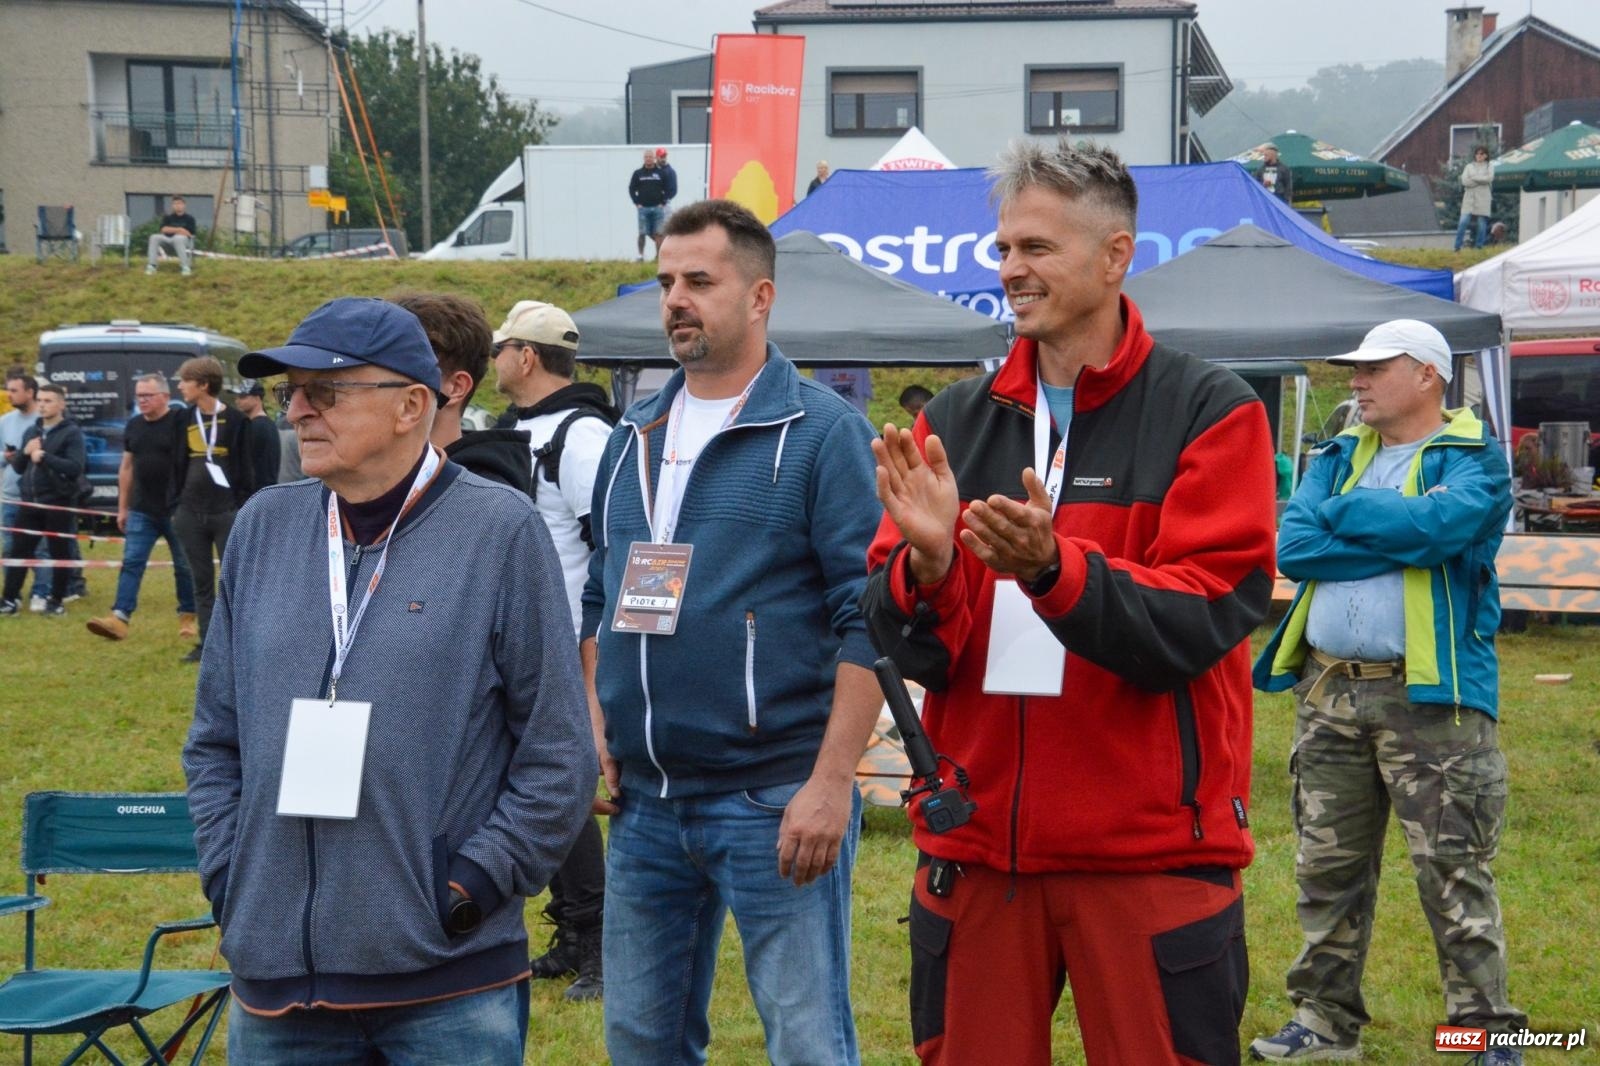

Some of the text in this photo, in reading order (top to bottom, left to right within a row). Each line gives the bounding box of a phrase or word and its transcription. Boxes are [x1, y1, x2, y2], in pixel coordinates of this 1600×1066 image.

[745, 83, 796, 97] Racibórz
[816, 226, 1001, 275] ostro
[329, 510, 338, 538] 2025
[117, 805, 166, 815] QUECHUA
